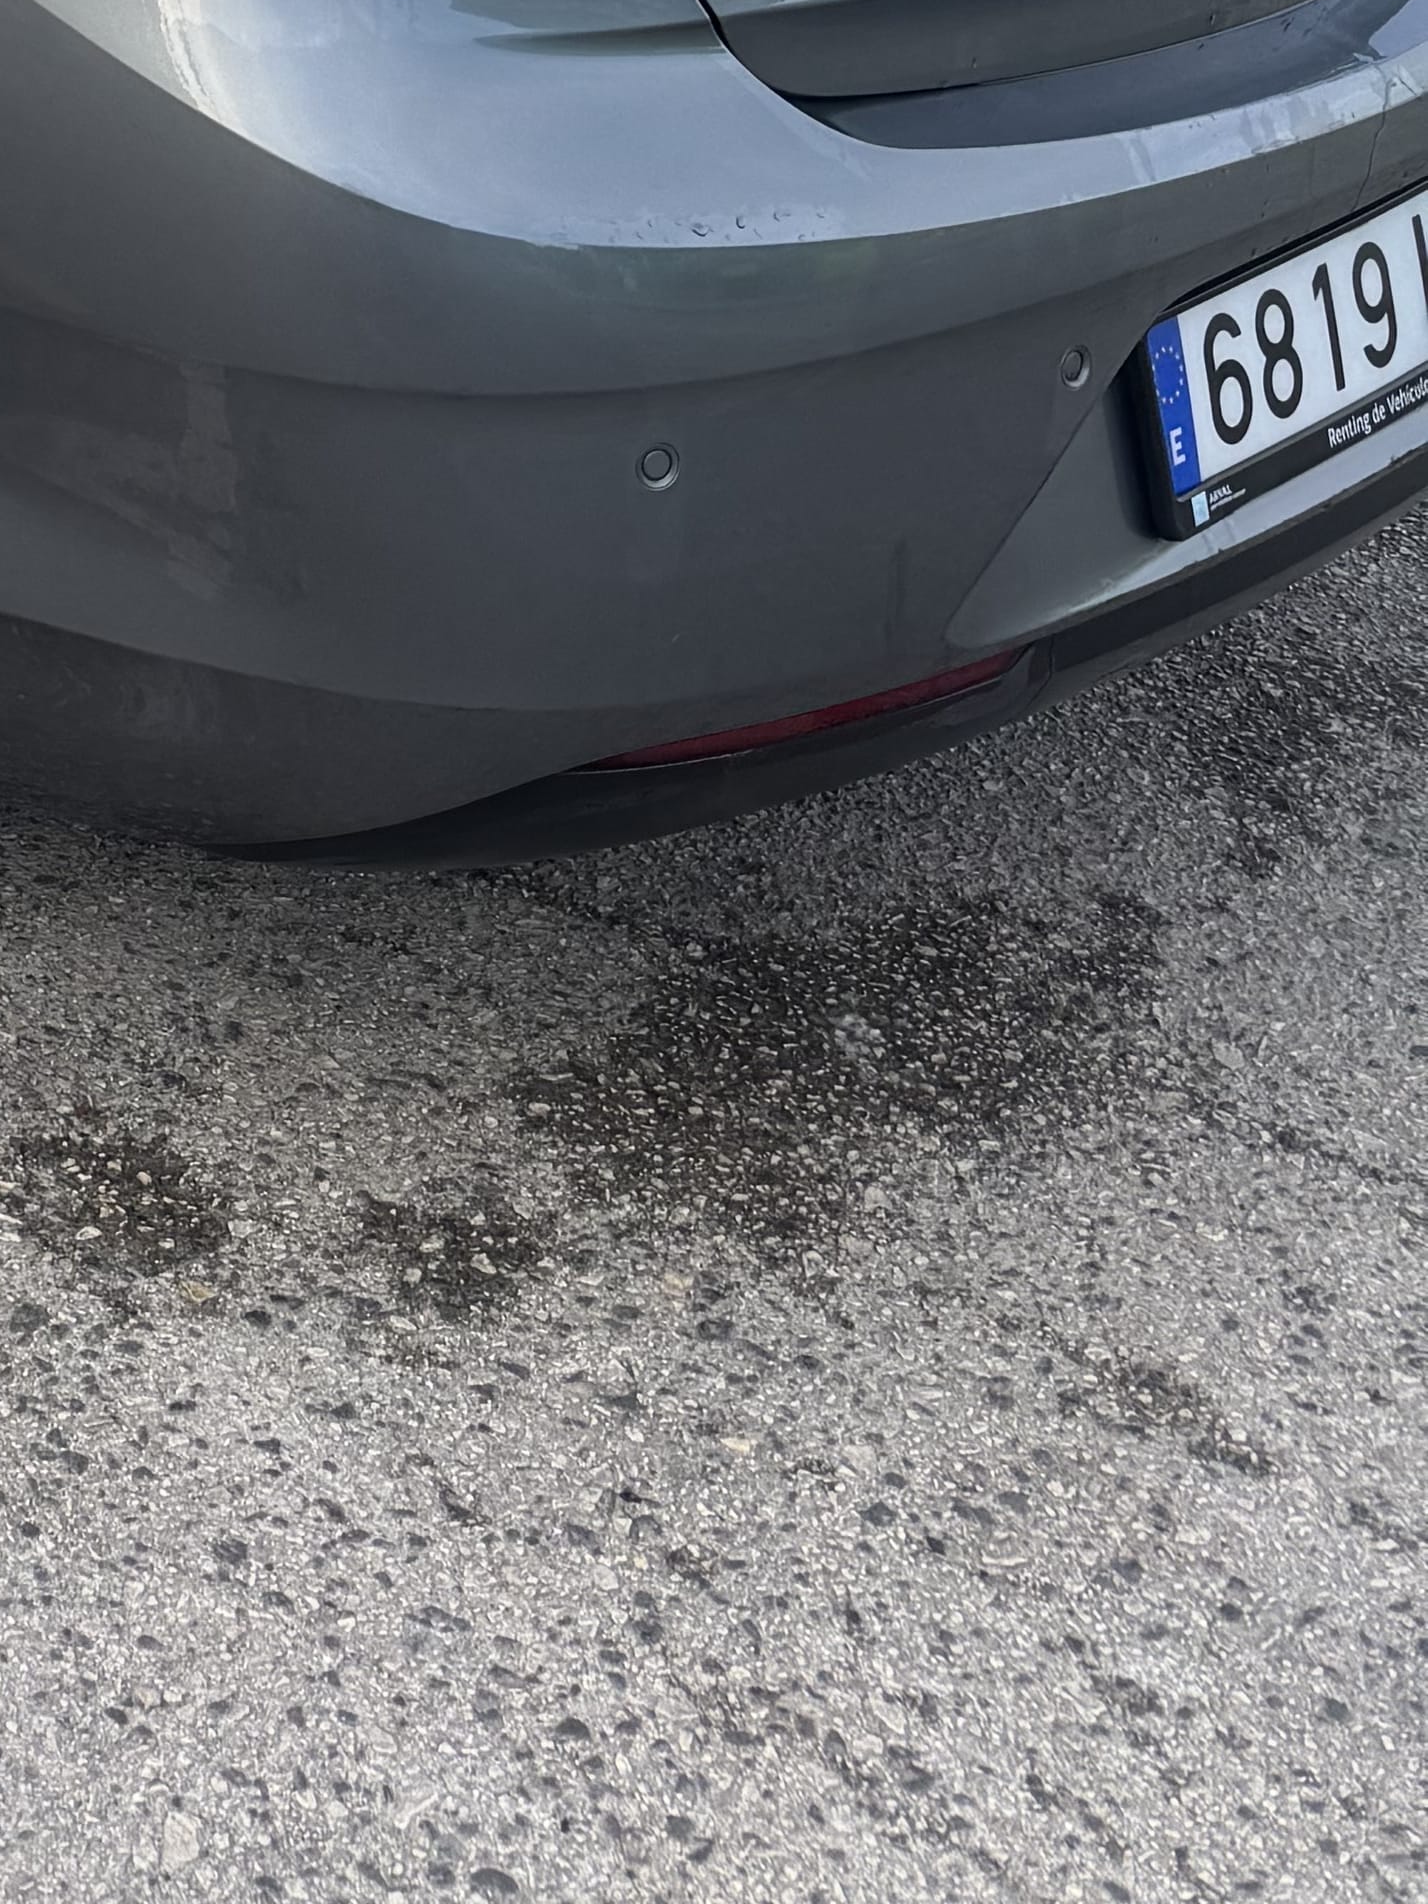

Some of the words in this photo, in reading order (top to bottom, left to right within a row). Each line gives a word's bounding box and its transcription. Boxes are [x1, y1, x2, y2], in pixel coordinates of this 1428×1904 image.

[1203, 241, 1398, 445] 6819
[1169, 426, 1186, 467] E
[1327, 412, 1372, 449] Renting
[1372, 402, 1386, 424] de
